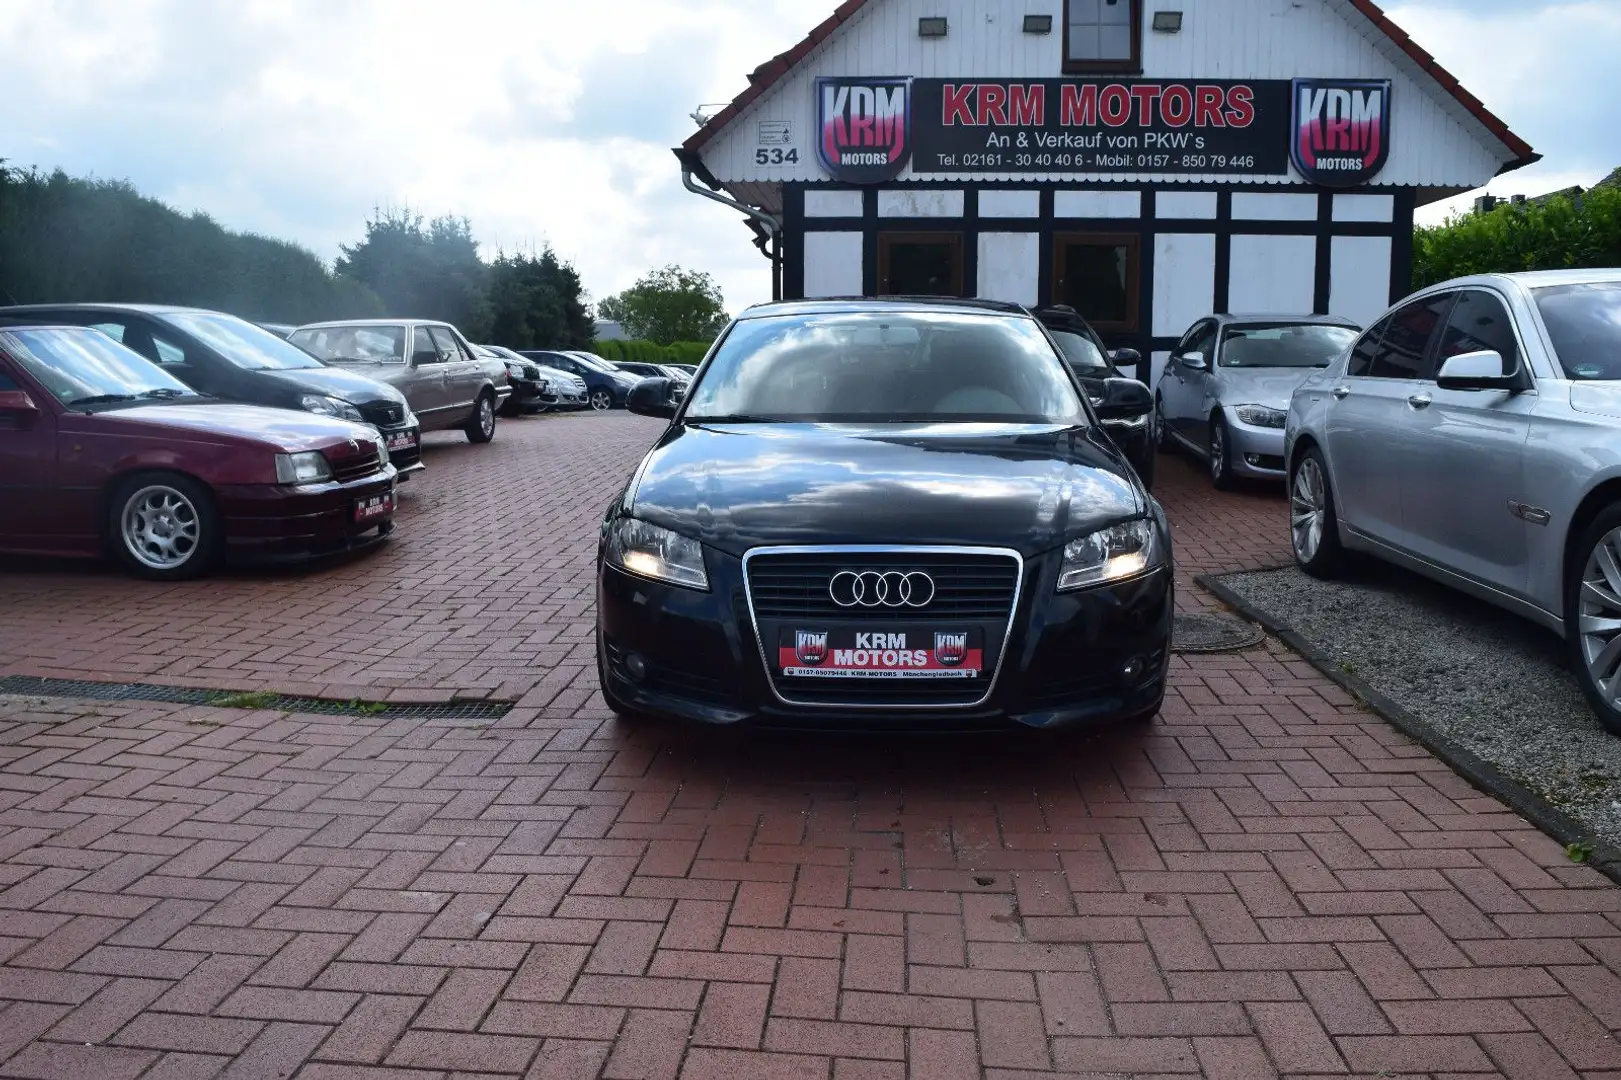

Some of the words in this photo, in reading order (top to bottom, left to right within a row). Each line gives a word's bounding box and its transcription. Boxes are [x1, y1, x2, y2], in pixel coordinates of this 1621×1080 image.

[942, 84, 1045, 126] KRM
[1060, 84, 1255, 128] MOTORS
[825, 86, 904, 163] KRM
[1300, 88, 1381, 168] KRM
[986, 132, 1010, 148] An
[1016, 132, 1029, 148] &
[1035, 132, 1102, 148] Verkauf
[1107, 136, 1137, 148] von
[756, 148, 799, 165] 534
[841, 153, 888, 165] MOTORS
[937, 154, 959, 166] Tel.
[963, 154, 1002, 166] 02161
[1015, 154, 1031, 166] 30
[1035, 154, 1051, 166] 40
[1055, 154, 1071, 166] 40
[1075, 154, 1083, 166] 6
[1096, 154, 1133, 167] Mobil:
[1137, 155, 1170, 167] 0157
[1182, 155, 1206, 167] 850
[1210, 155, 1226, 168] 79
[1229, 155, 1254, 168] 446
[1316, 158, 1363, 170] MOTORS
[856, 632, 906, 649] KRM
[834, 649, 927, 666] MOTORS
